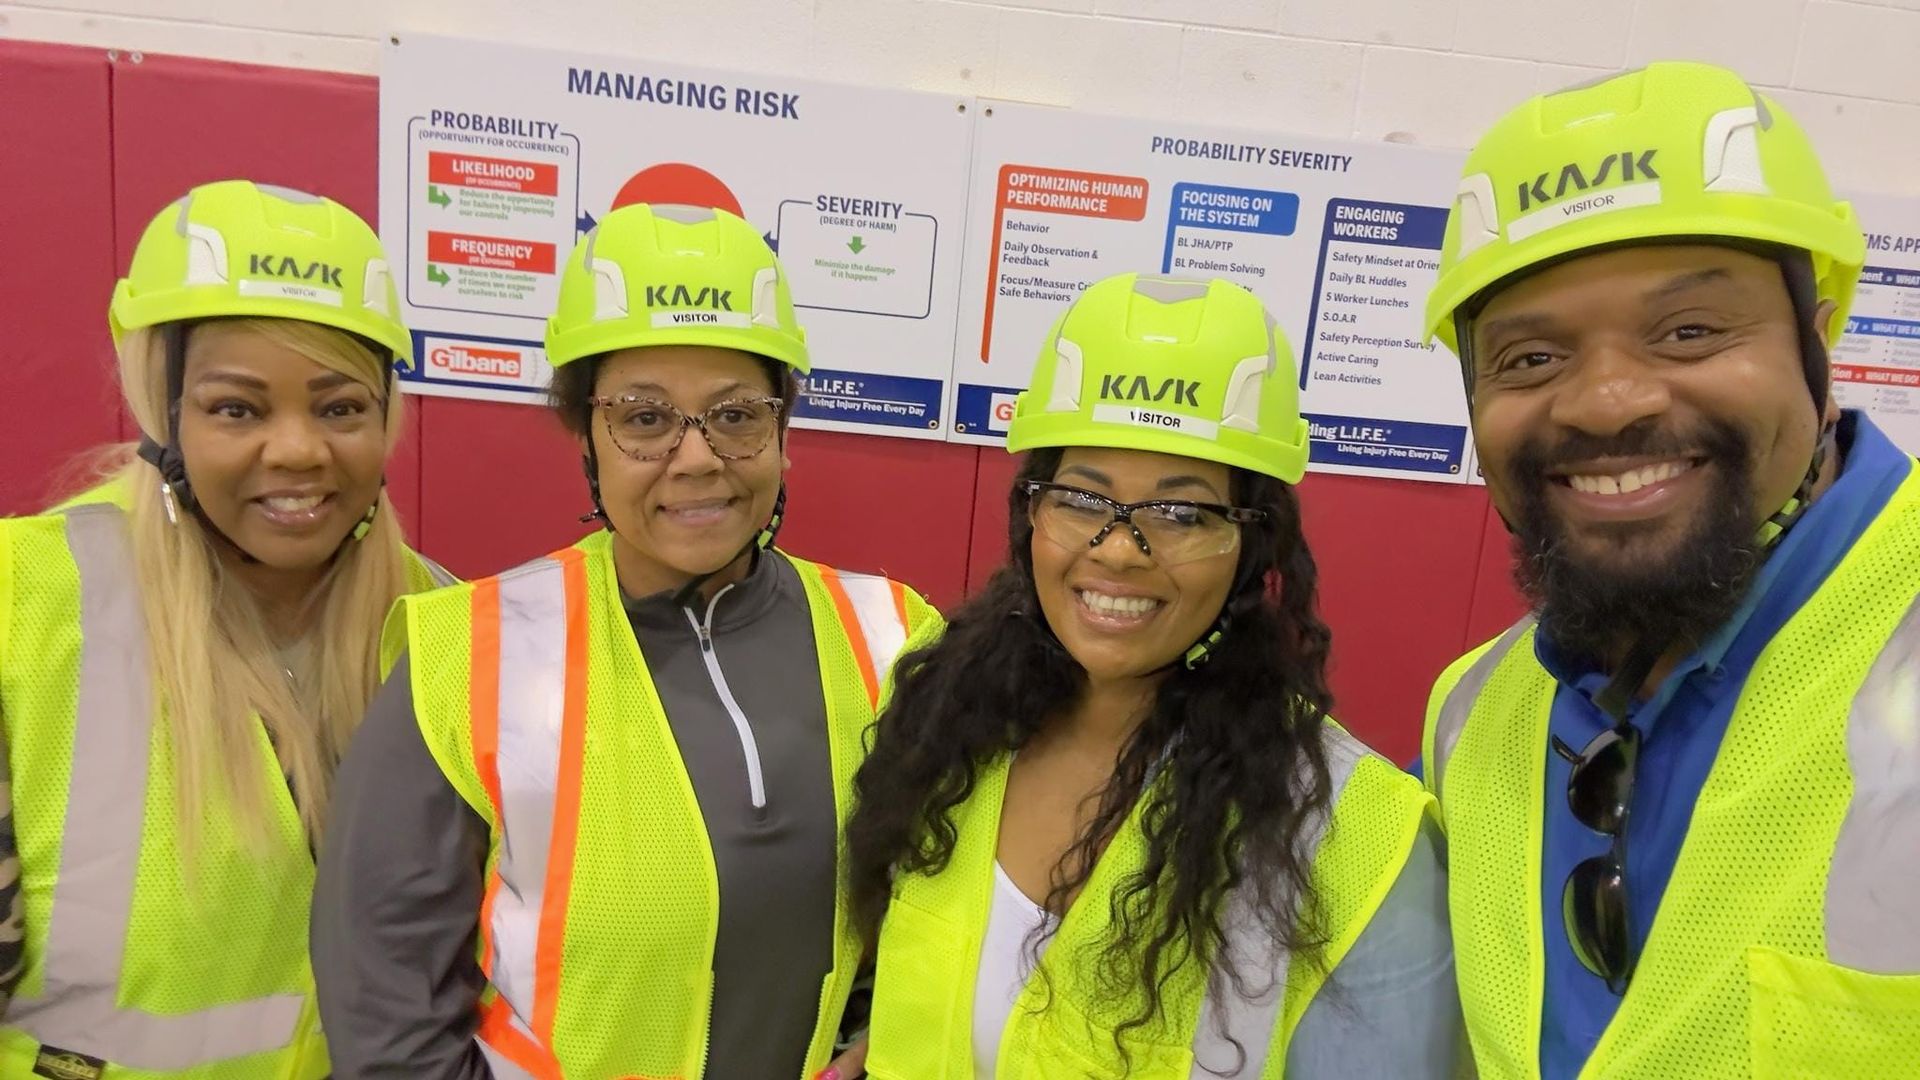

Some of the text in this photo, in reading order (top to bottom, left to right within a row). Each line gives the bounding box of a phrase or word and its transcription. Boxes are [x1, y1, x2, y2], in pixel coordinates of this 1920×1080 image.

[567, 67, 800, 120] MANAGING RISK
[431, 109, 558, 140] PROBABILITY
[418, 130, 569, 156] (OPPORTUNITY FOR OCCURRENCE)
[1151, 136, 1353, 173] PROBABILITY SEVERITY
[452, 159, 535, 181] LIKELIHOOD
[1008, 172, 1143, 199] OPTIMIZING HUMAN
[1518, 149, 1660, 212] KASK
[816, 194, 903, 220] SEVERITY
[1007, 189, 1108, 213] PERFORMANCE
[1181, 190, 1273, 212] FOCUSING ON
[1562, 194, 1615, 216] VISITOR
[820, 216, 897, 232] (DEGREE OF HARM)
[1180, 207, 1260, 228] THE SYSTEM
[1335, 205, 1405, 225] ENGAGING
[1006, 220, 1051, 234] Behavior
[1333, 221, 1398, 241] WORKERS
[451, 238, 533, 260] FREQUENCY
[1003, 240, 1099, 259] Daily Observation &
[1177, 237, 1234, 251] BL JHA/PTP
[1863, 233, 1891, 251] MS
[814, 258, 896, 276] Minimize the damage
[1002, 253, 1050, 268] Feedback
[1175, 257, 1266, 278] BL Problem Solving
[1332, 251, 1364, 266] Safety
[1364, 254, 1404, 268] Mindset
[1405, 259, 1415, 268] at
[249, 253, 344, 289] KASK
[845, 271, 878, 283] happens
[1329, 271, 1407, 288] Daily BL Huddles
[281, 286, 317, 298] VISITOR
[1000, 273, 1076, 291] Focus/Measure
[646, 284, 733, 312] KASK
[999, 286, 1071, 302] Safe Behaviors
[1325, 291, 1409, 309] 5 Worker Lunches
[672, 313, 718, 323] VISITOR
[1322, 311, 1358, 324] S.O.A.R
[1319, 331, 1351, 346] Safety
[1351, 334, 1402, 348] Perception
[431, 347, 520, 376] Gilbane
[1316, 351, 1379, 368] Active Caring
[1313, 371, 1382, 386] Lean Activities
[1100, 374, 1201, 407] KASK
[808, 397, 925, 417] Living Injury Free Every Day
[1337, 443, 1449, 462] Living Injury Free Every Day
